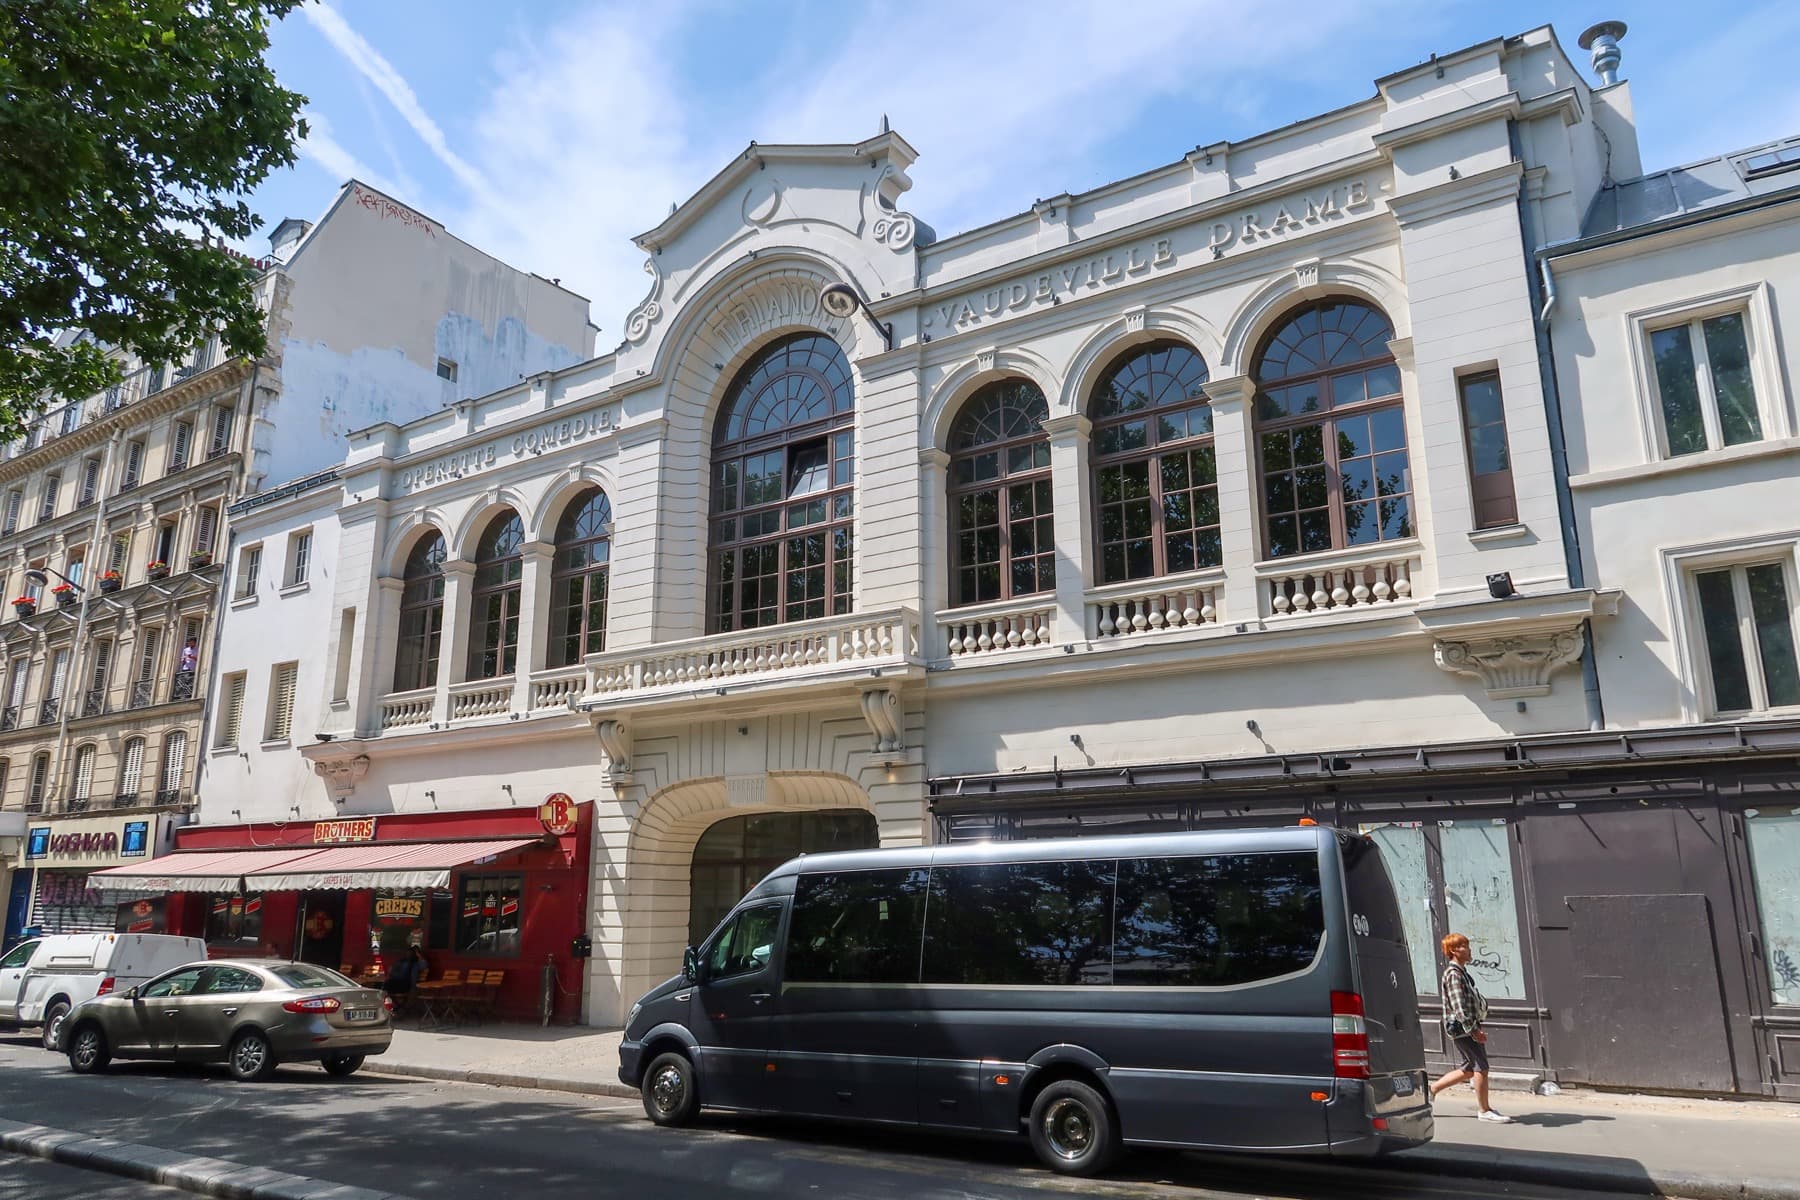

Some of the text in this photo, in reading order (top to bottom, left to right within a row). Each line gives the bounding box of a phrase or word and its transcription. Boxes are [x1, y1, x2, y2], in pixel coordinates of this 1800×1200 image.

[935, 179, 1369, 329] VAUDEVILLE DRAME
[401, 409, 612, 489] OPERETTE COMEDIE
[314, 819, 375, 840] BROTHERS
[551, 801, 569, 826] B
